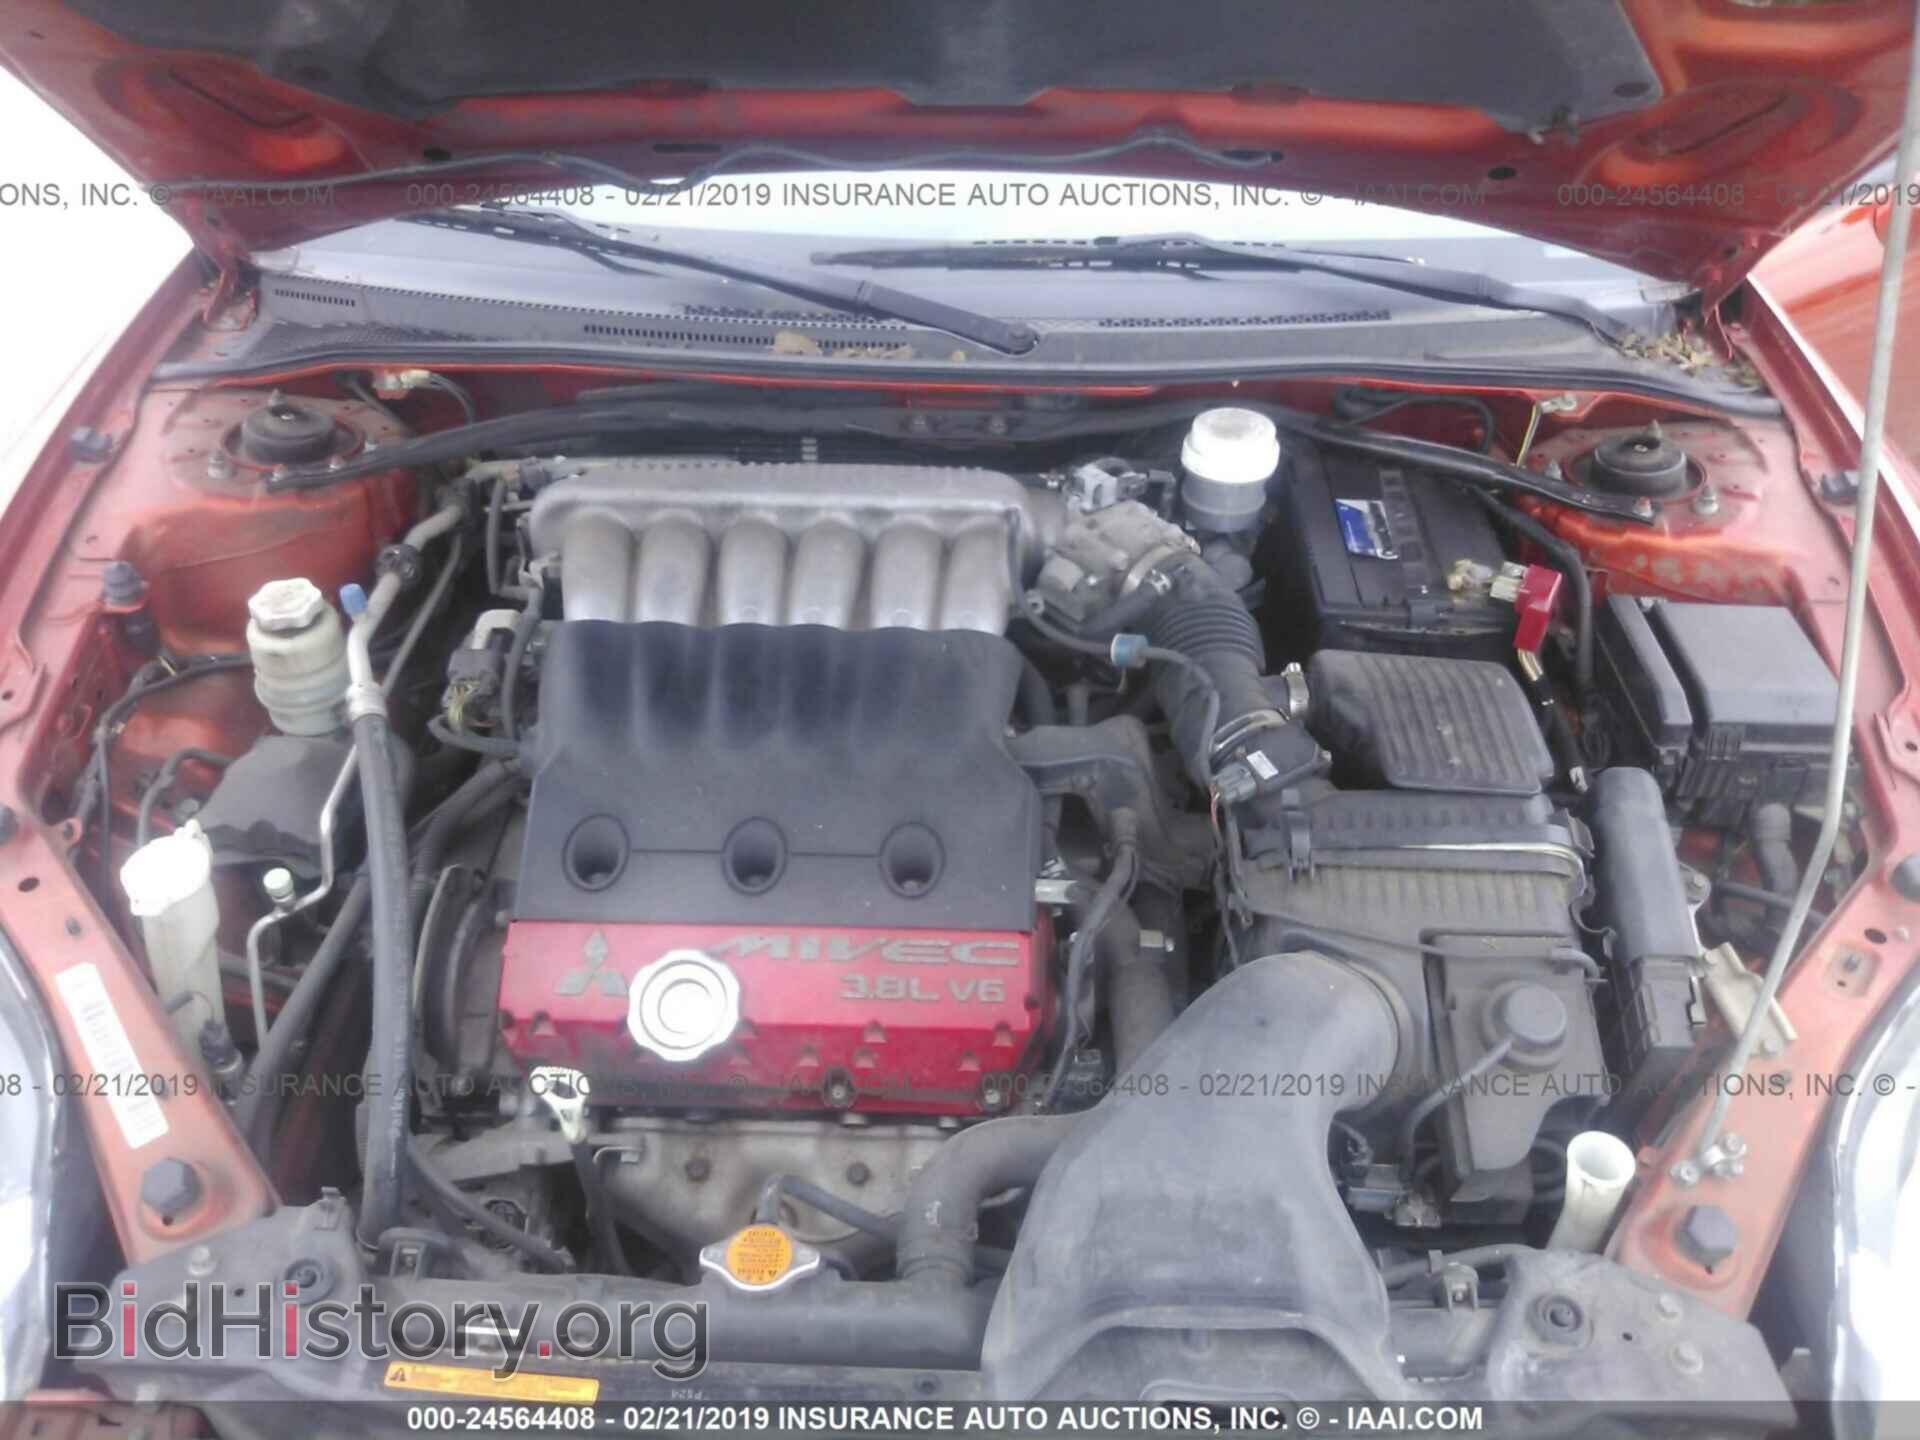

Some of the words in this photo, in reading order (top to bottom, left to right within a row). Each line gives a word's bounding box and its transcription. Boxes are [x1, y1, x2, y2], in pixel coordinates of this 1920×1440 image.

[707, 935, 1019, 966] MIVEC
[840, 975, 939, 1001] 3.8L
[947, 979, 1007, 1002] V6
